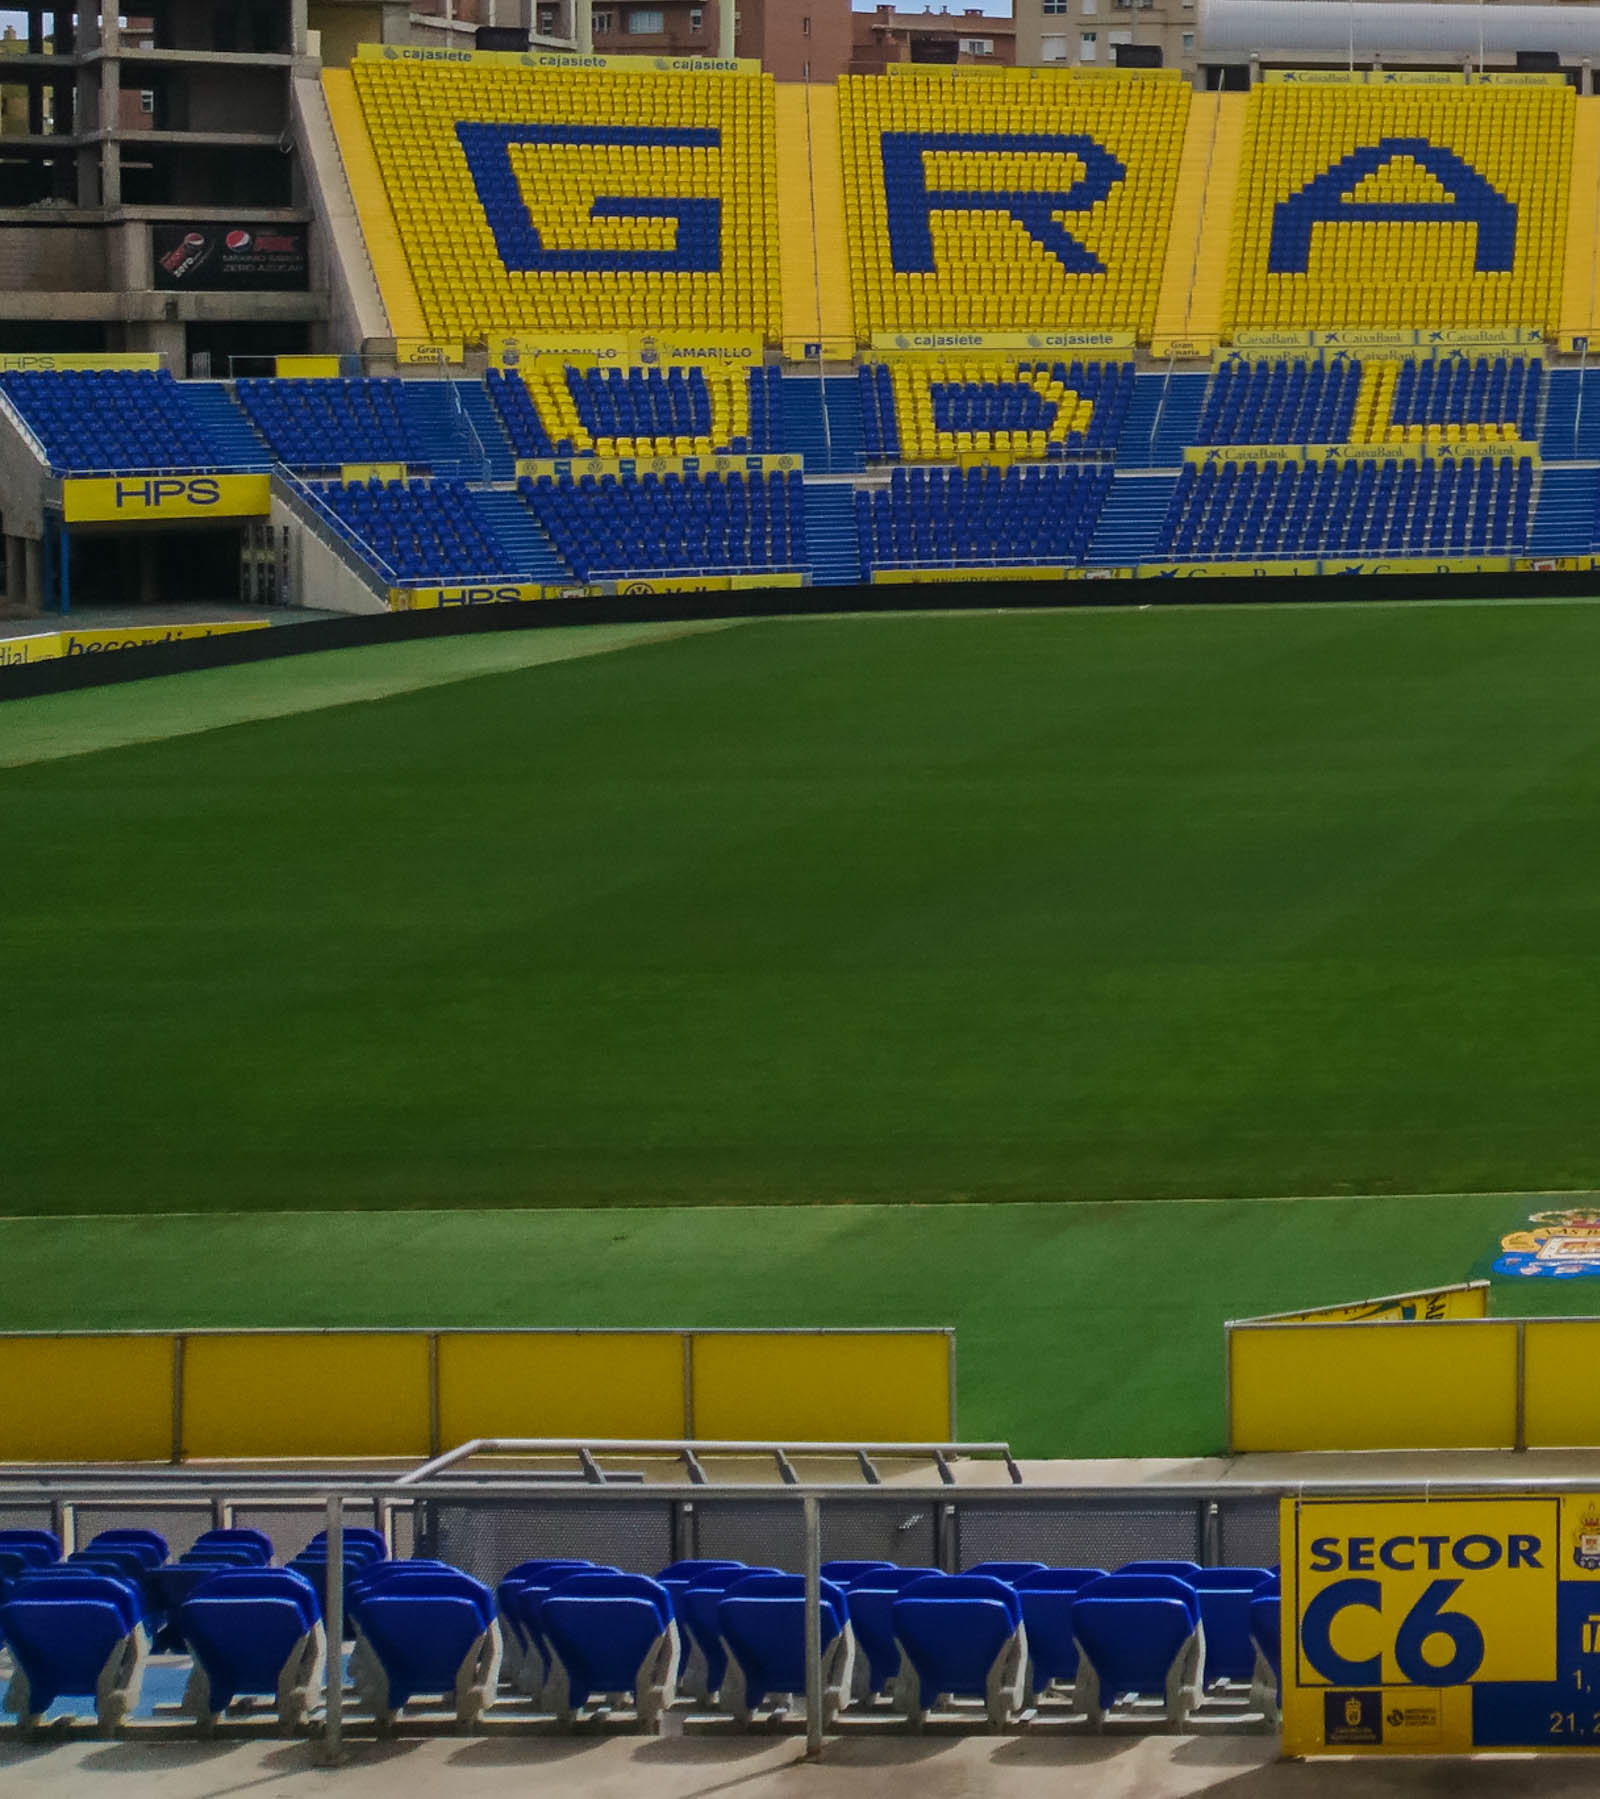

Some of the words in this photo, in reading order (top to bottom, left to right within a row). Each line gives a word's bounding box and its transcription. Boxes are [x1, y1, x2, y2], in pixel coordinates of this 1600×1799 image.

[402, 49, 472, 63] cajasiete
[539, 55, 607, 69] cajasiete
[672, 58, 738, 72] cajasiete
[914, 334, 982, 346] cajasiete
[1046, 334, 1113, 346] cajasiete
[672, 348, 752, 358] AMARILLO
[3, 357, 55, 369] HPS
[1224, 448, 1288, 459] CaixaBank
[1454, 445, 1514, 456] CaixaBank
[116, 479, 220, 508] HPS
[1309, 1534, 1545, 1572] SECTOR
[1300, 1578, 1485, 1688] C6
[1550, 1713, 1585, 1736] 21,
